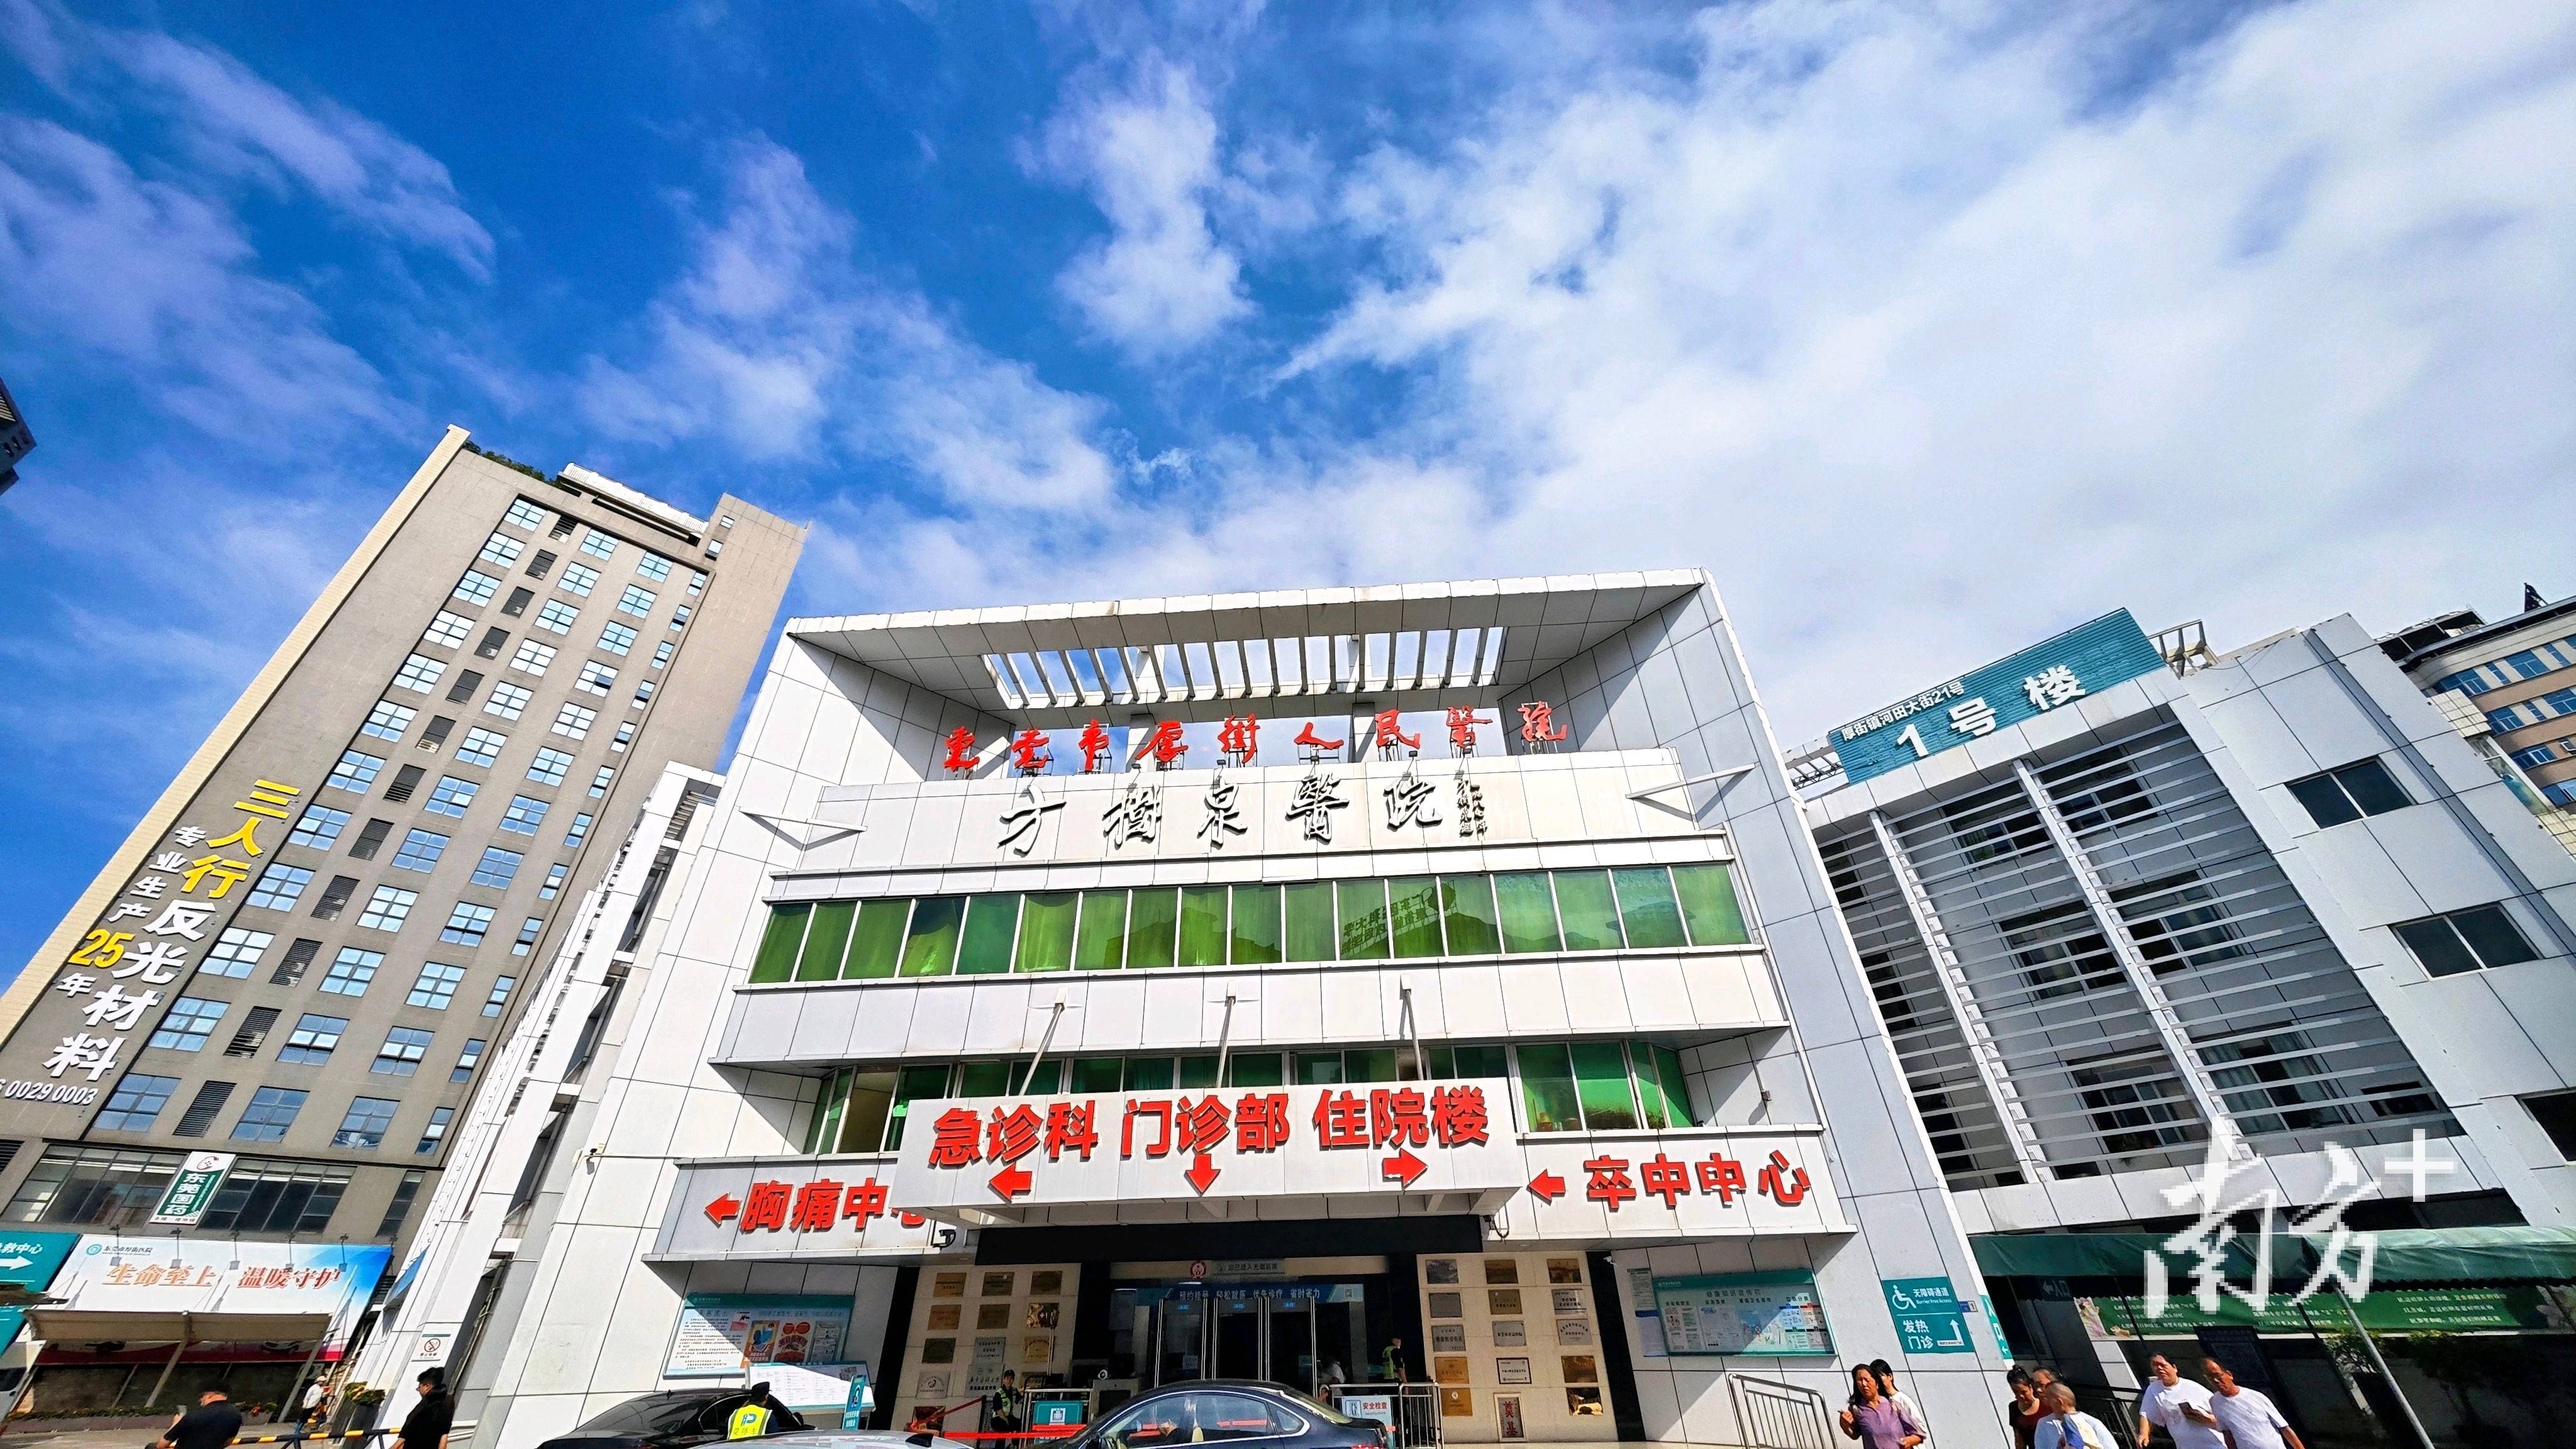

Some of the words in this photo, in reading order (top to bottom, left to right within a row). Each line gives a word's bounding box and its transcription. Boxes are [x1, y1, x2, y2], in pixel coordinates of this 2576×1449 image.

[1841, 680, 1965, 741] 厚街镇河田大街21号
[1897, 664, 2086, 758] 1号楼
[997, 769, 1443, 854] 方樹泉醫院
[43, 779, 301, 1081] 三人行反光材料
[5, 1080, 54, 1100] 0029
[52, 1085, 99, 1105] 0003
[928, 1099, 1099, 1167] 急诊科
[1121, 1093, 1289, 1158] 门诊部
[1313, 1085, 1490, 1150] 住院楼
[164, 1173, 209, 1215] 东莞国药
[1583, 1149, 1811, 1211] 卒中中心
[0, 1242, 43, 1254] 救中心
[103, 1263, 216, 1287] 生命至上
[237, 1266, 342, 1290] 温暖守护
[1290, 1288, 1321, 1299] 省时省力
[1913, 1287, 1950, 1297] 无障碍通道
[1903, 1319, 1929, 1333] 发热
[1984, 1299, 2004, 1341] 入口
[1908, 1336, 1934, 1350] 门诊
